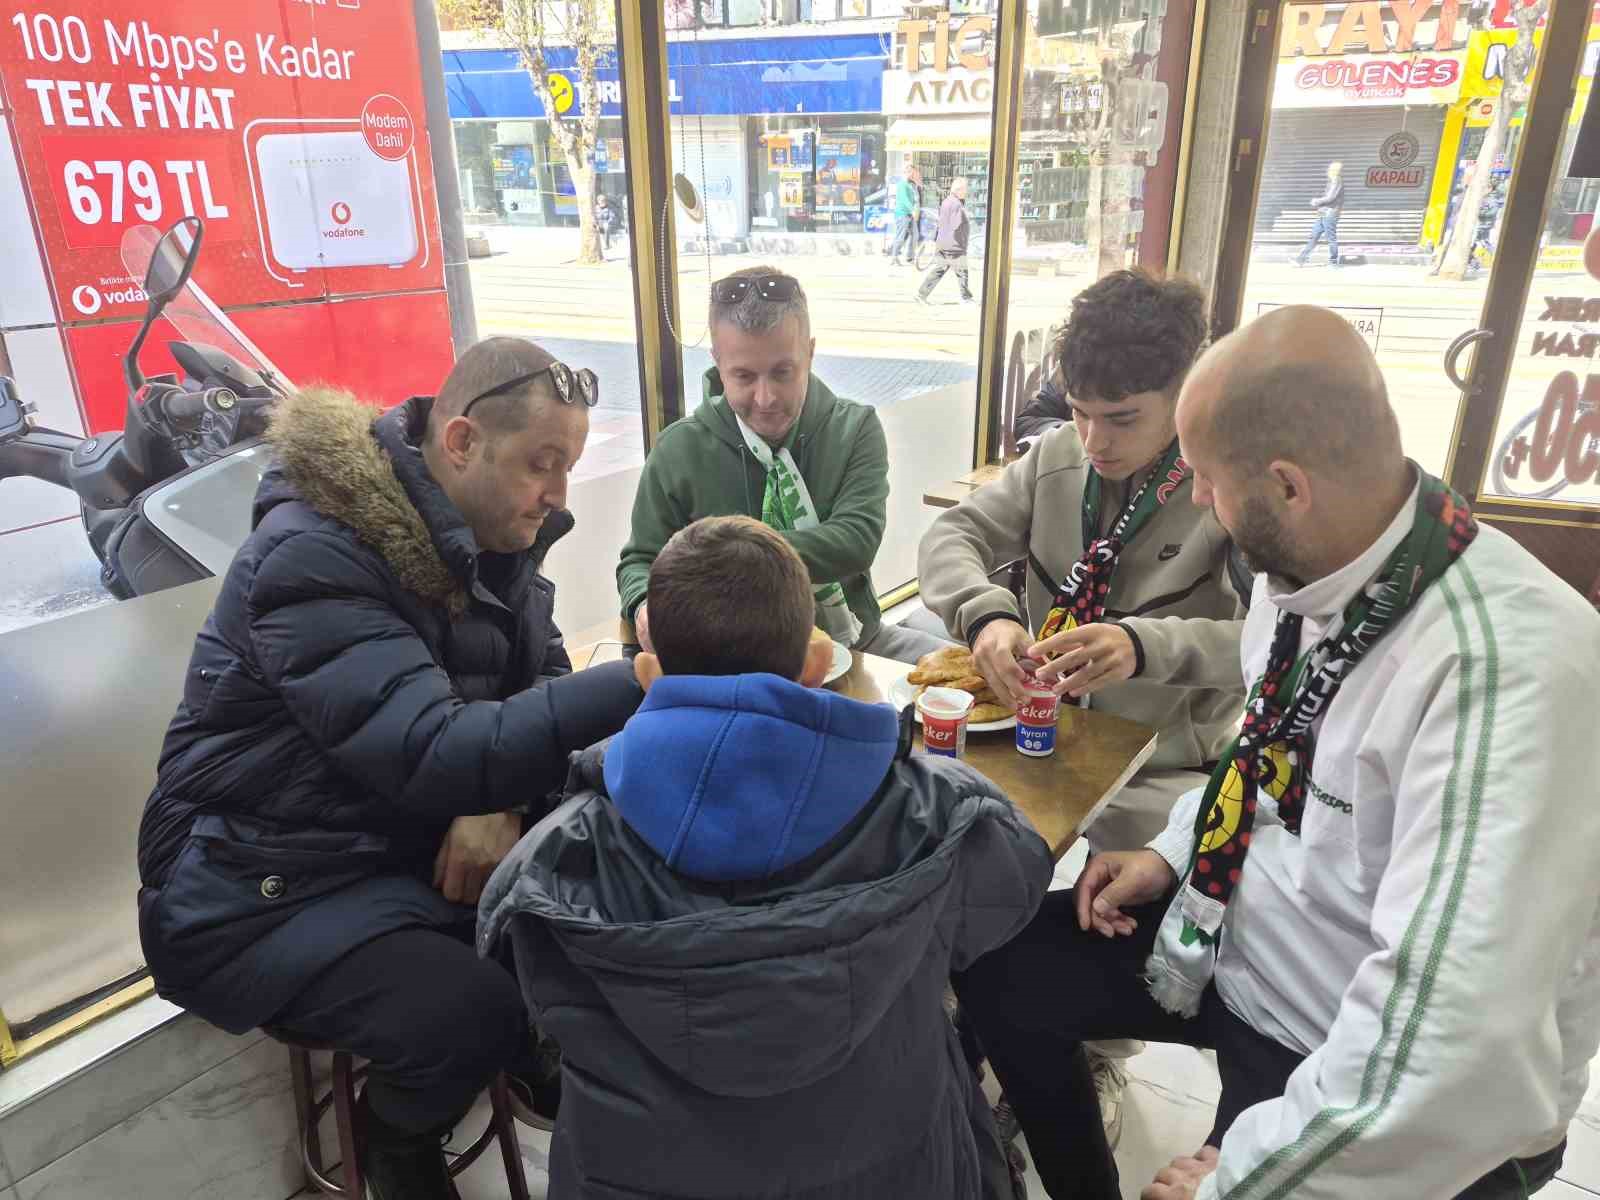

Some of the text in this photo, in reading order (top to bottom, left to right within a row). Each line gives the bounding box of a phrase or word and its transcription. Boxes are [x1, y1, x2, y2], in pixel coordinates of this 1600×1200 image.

[13, 12, 355, 82] 100 Mbps'e Kadar
[26, 72, 236, 130] TEK FİYAT
[365, 112, 408, 129] Modem
[375, 132, 404, 148] Dahil
[1368, 170, 1421, 184] KAPALI
[63, 160, 230, 225] 679 TL
[323, 228, 366, 238] vodafone
[1022, 705, 1053, 719] eker
[1020, 727, 1047, 738] Ayran
